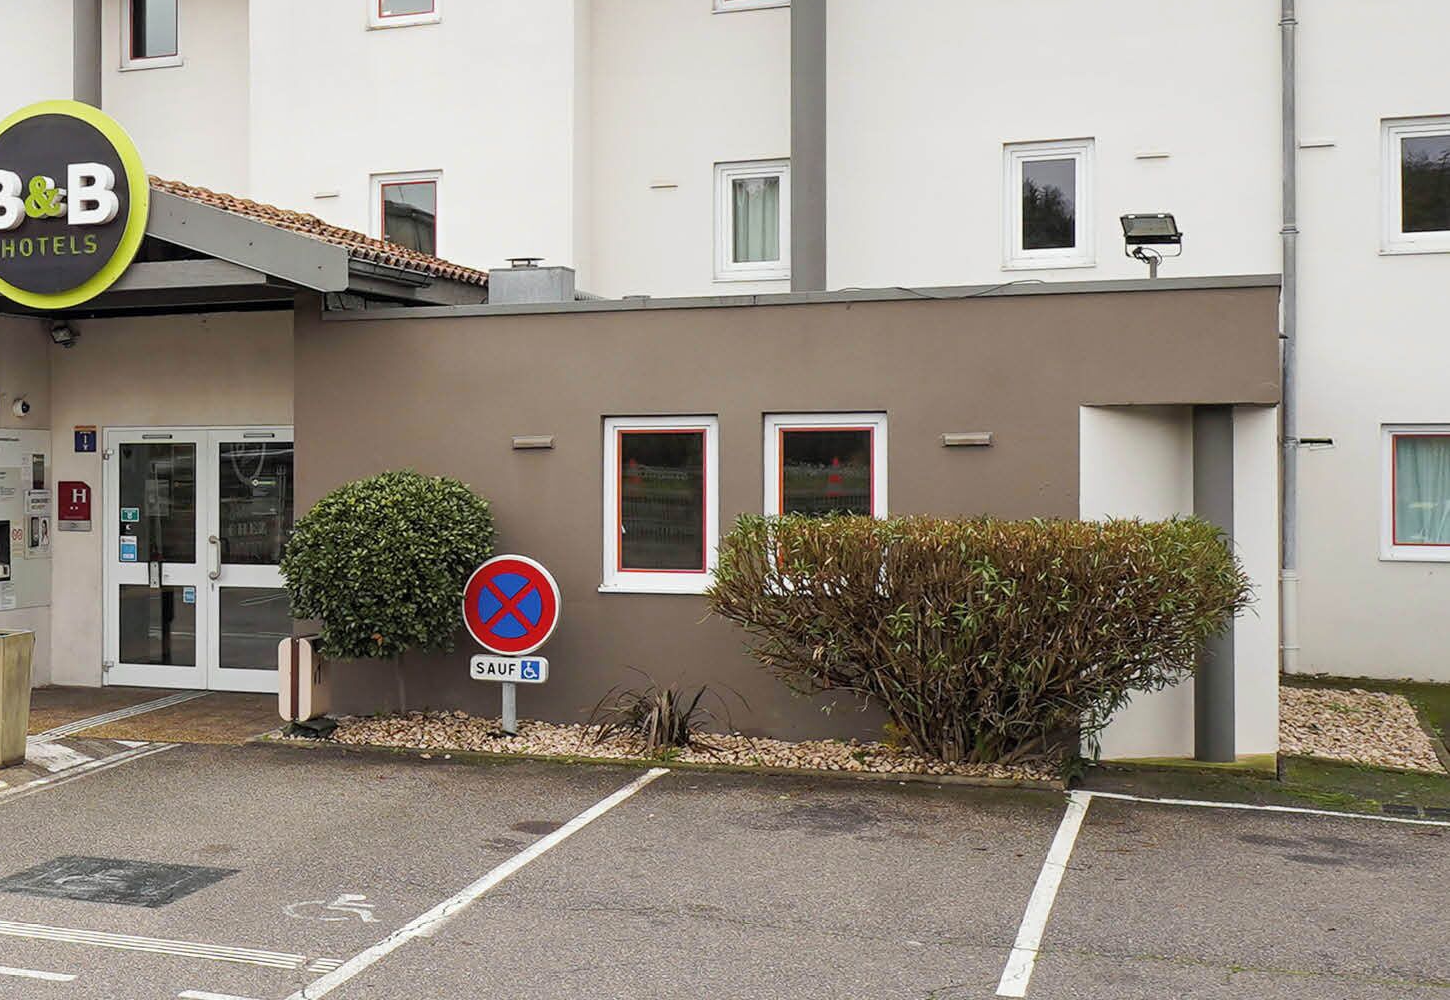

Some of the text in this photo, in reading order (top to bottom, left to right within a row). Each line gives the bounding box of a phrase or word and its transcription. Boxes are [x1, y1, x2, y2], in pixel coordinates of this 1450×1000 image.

[1, 234, 98, 259] HOTELS
[72, 488, 87, 504] H
[476, 662, 516, 675] SAUF
